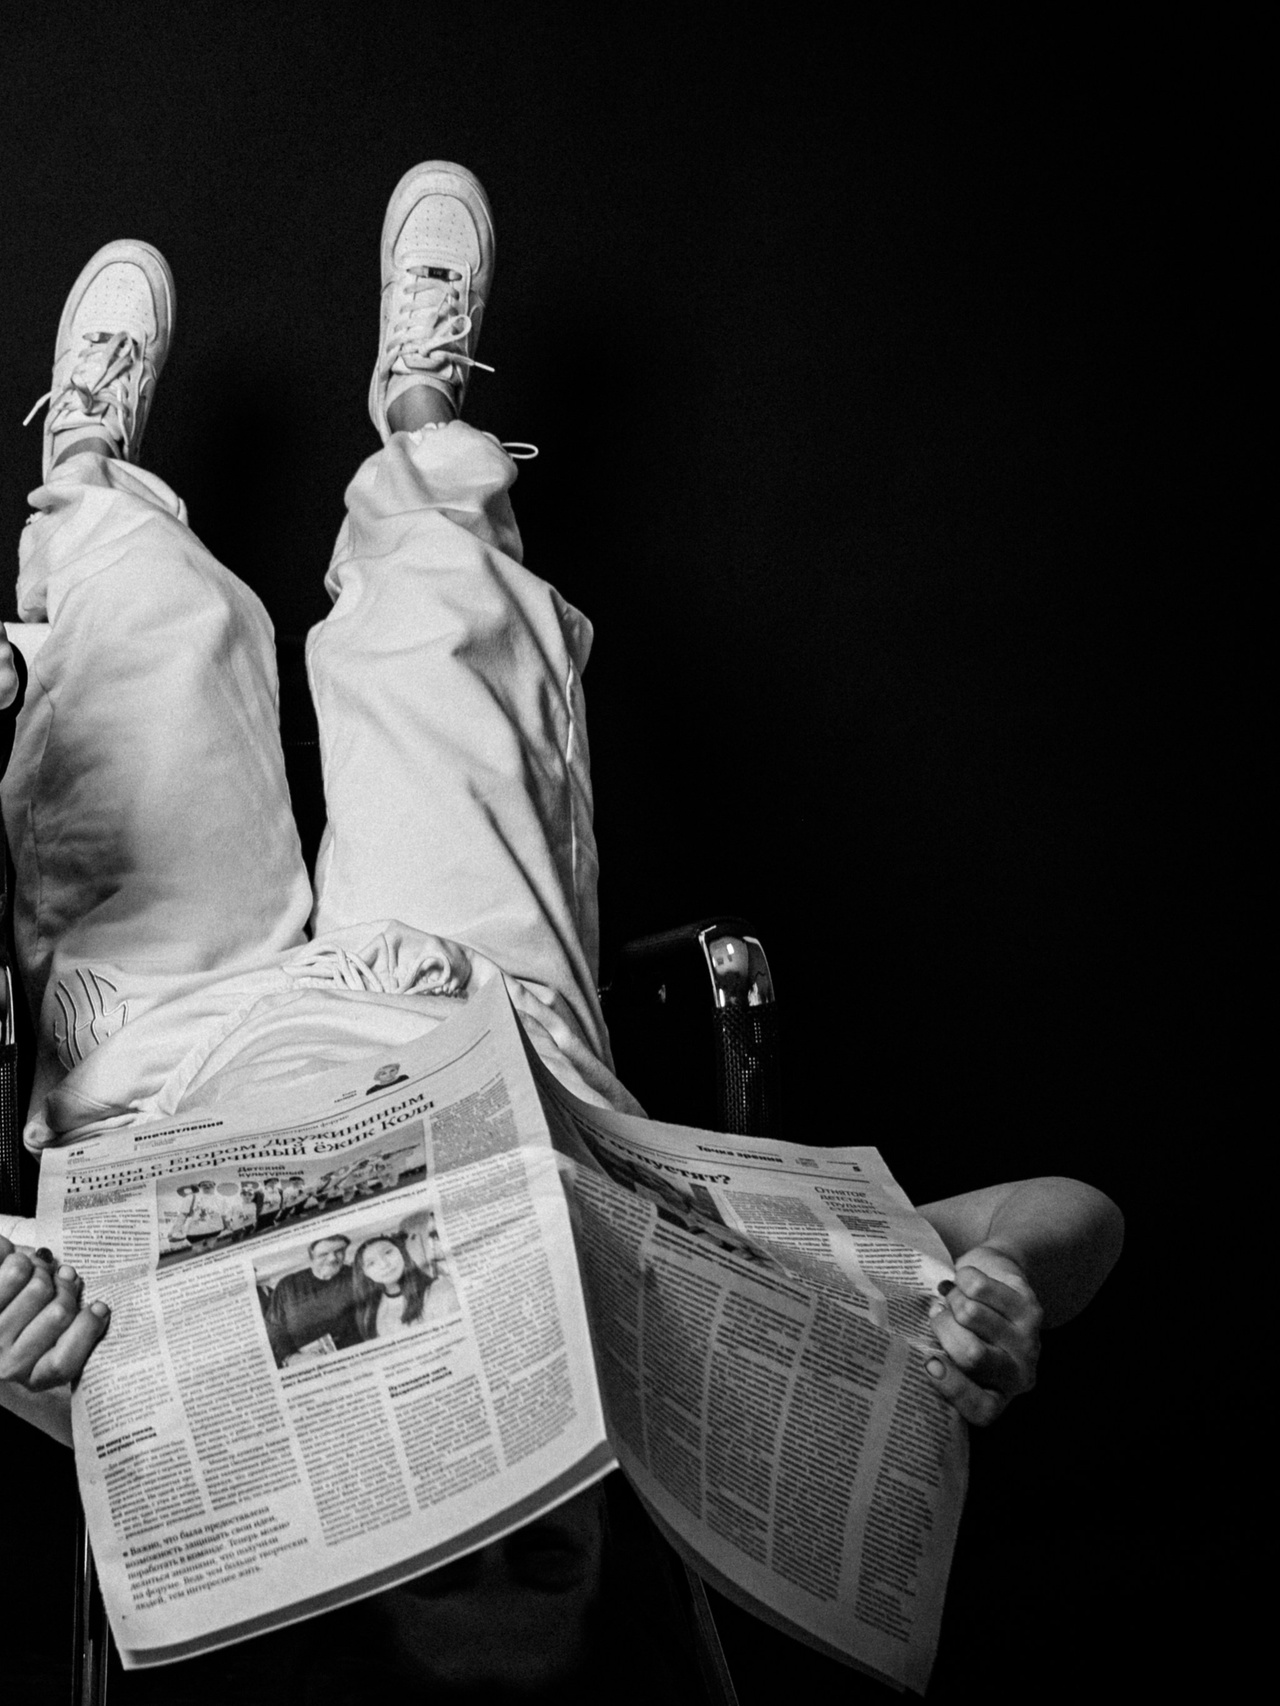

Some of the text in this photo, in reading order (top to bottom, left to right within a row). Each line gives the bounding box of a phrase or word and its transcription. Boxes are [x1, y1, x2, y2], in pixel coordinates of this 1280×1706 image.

[67, 1168, 142, 1184] Танцы
[170, 1143, 256, 1166] Егором
[263, 1093, 425, 1149] Дружининым
[89, 1145, 306, 1191] неразговорчивый
[314, 1128, 375, 1154] ёжик
[381, 1101, 436, 1131] Коля
[134, 1121, 223, 1142] Впечатления
[696, 1144, 784, 1164] Точка зрения
